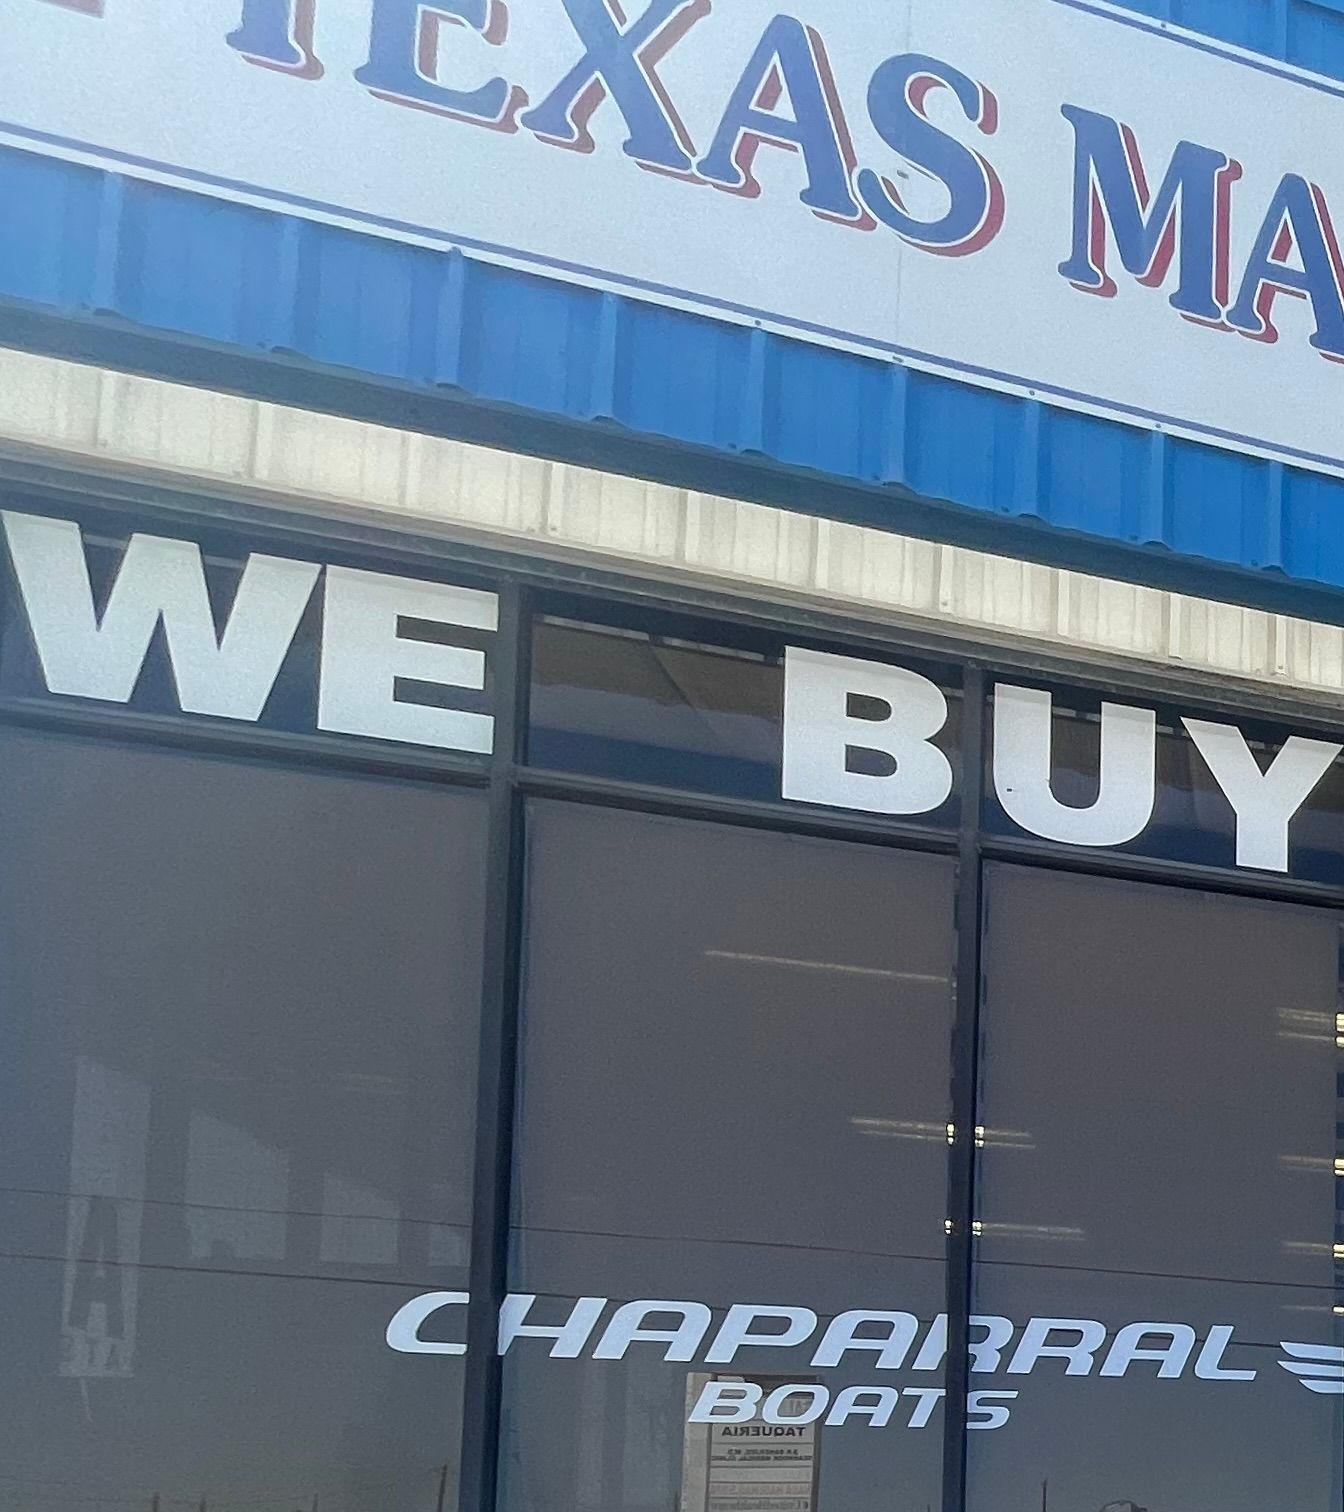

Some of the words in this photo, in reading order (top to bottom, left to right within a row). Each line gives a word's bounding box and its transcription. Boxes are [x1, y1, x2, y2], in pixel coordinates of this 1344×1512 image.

[1, 509, 499, 755] WE
[782, 645, 1344, 873] BUY
[386, 1291, 1257, 1382] CHAPARRAL
[687, 1380, 1019, 1430] BOATS
